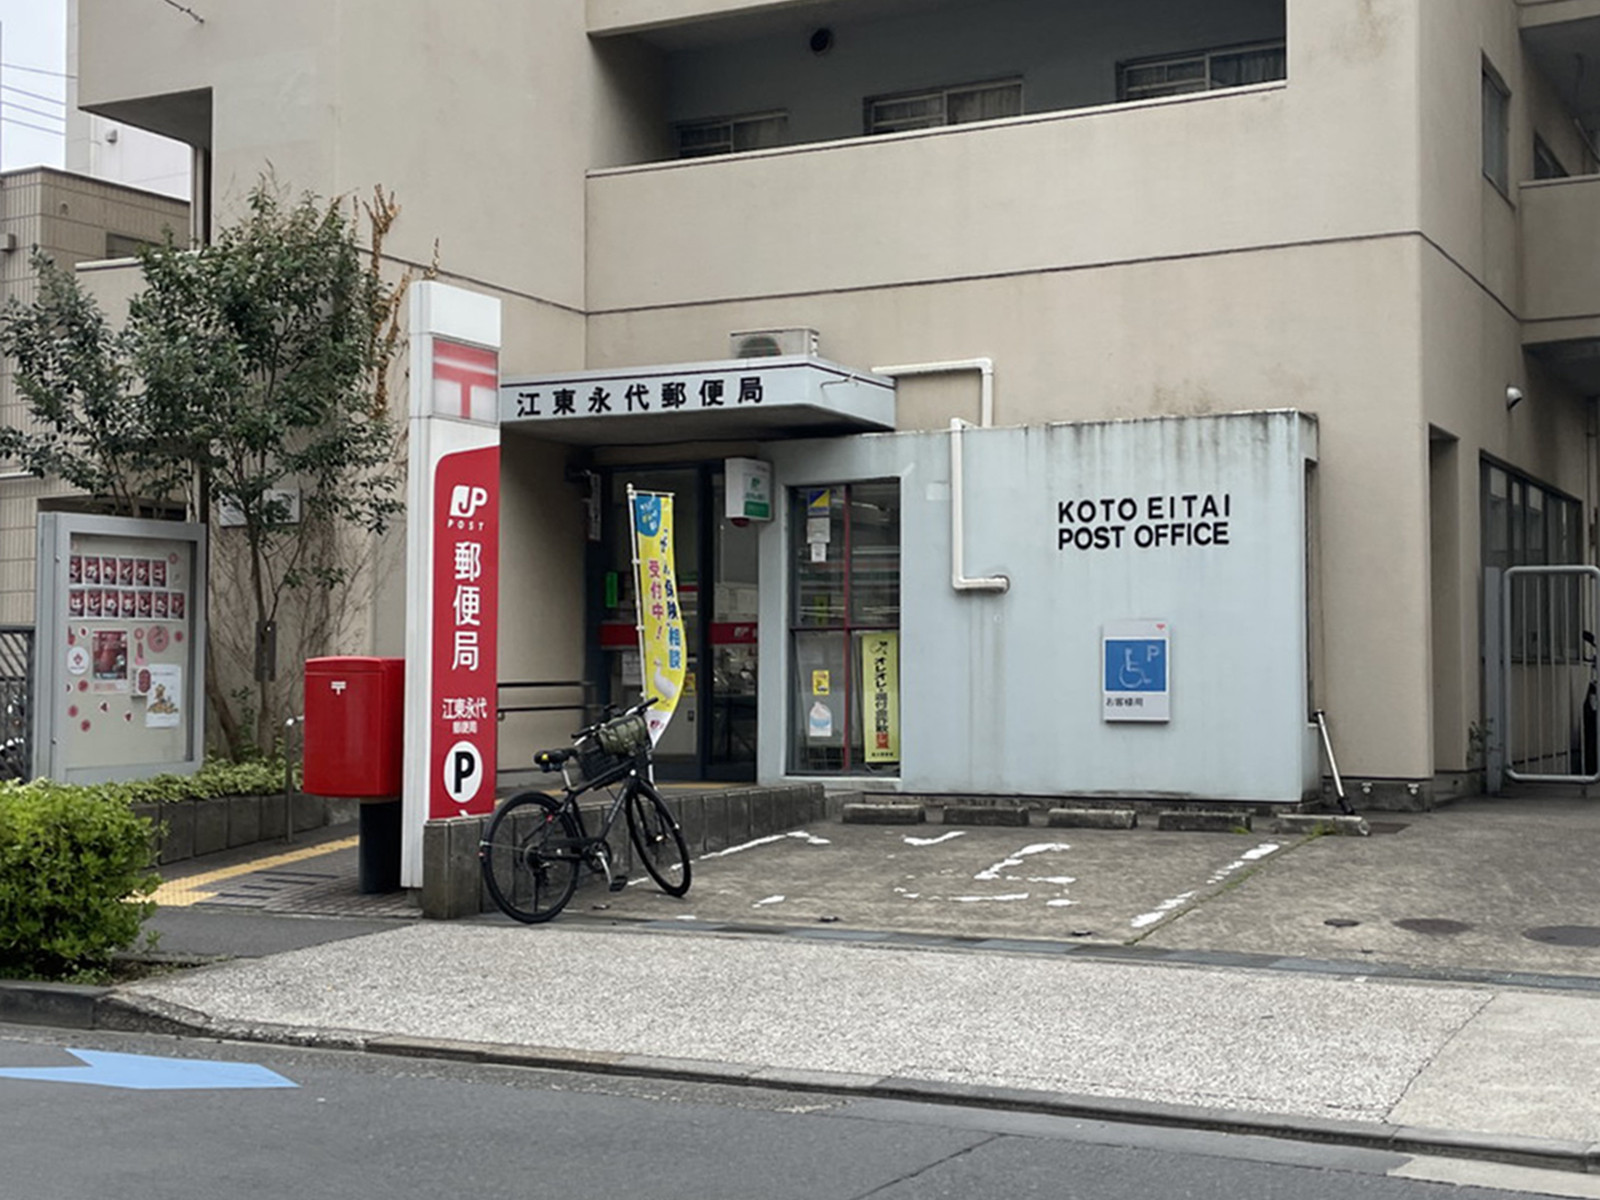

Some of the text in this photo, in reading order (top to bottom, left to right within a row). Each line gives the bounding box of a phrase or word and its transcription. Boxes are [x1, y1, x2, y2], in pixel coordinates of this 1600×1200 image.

[517, 377, 763, 417] 江東永代郵便局
[1058, 494, 1230, 523] KOTO EITAI
[447, 519, 485, 531] POST
[1058, 522, 1229, 550] POST OFFICE
[451, 541, 482, 671] 郵便局
[1147, 645, 1160, 662] P
[441, 697, 488, 719] 江東永代
[454, 750, 475, 794] P
